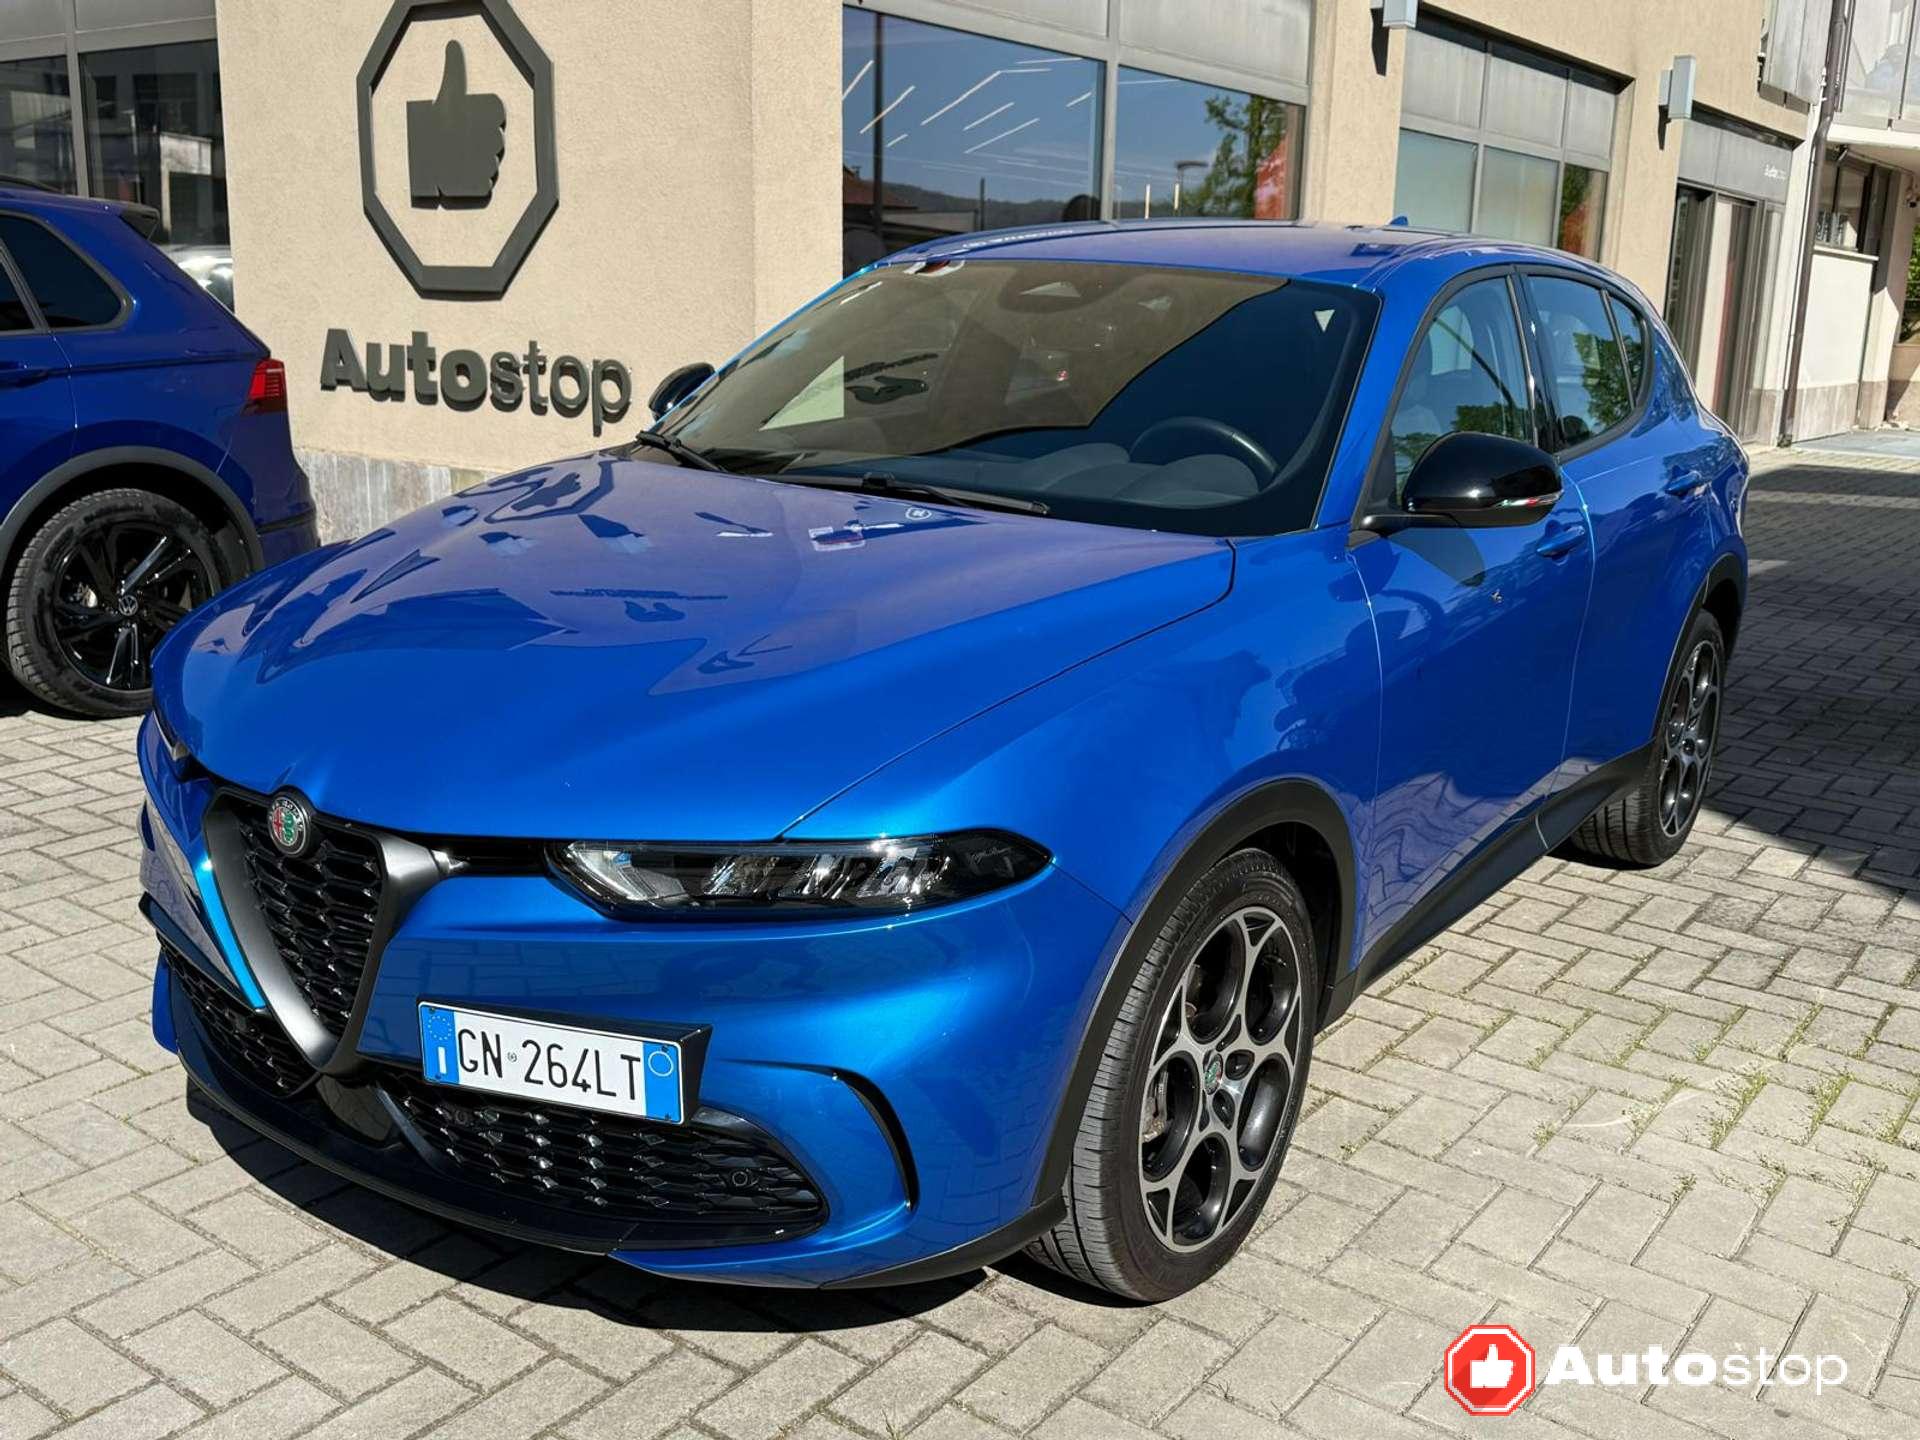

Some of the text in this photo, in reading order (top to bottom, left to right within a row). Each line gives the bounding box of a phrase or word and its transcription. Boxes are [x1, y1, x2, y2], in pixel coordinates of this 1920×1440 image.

[320, 327, 632, 437] Autostop
[457, 1028, 641, 1101] GN 264LT
